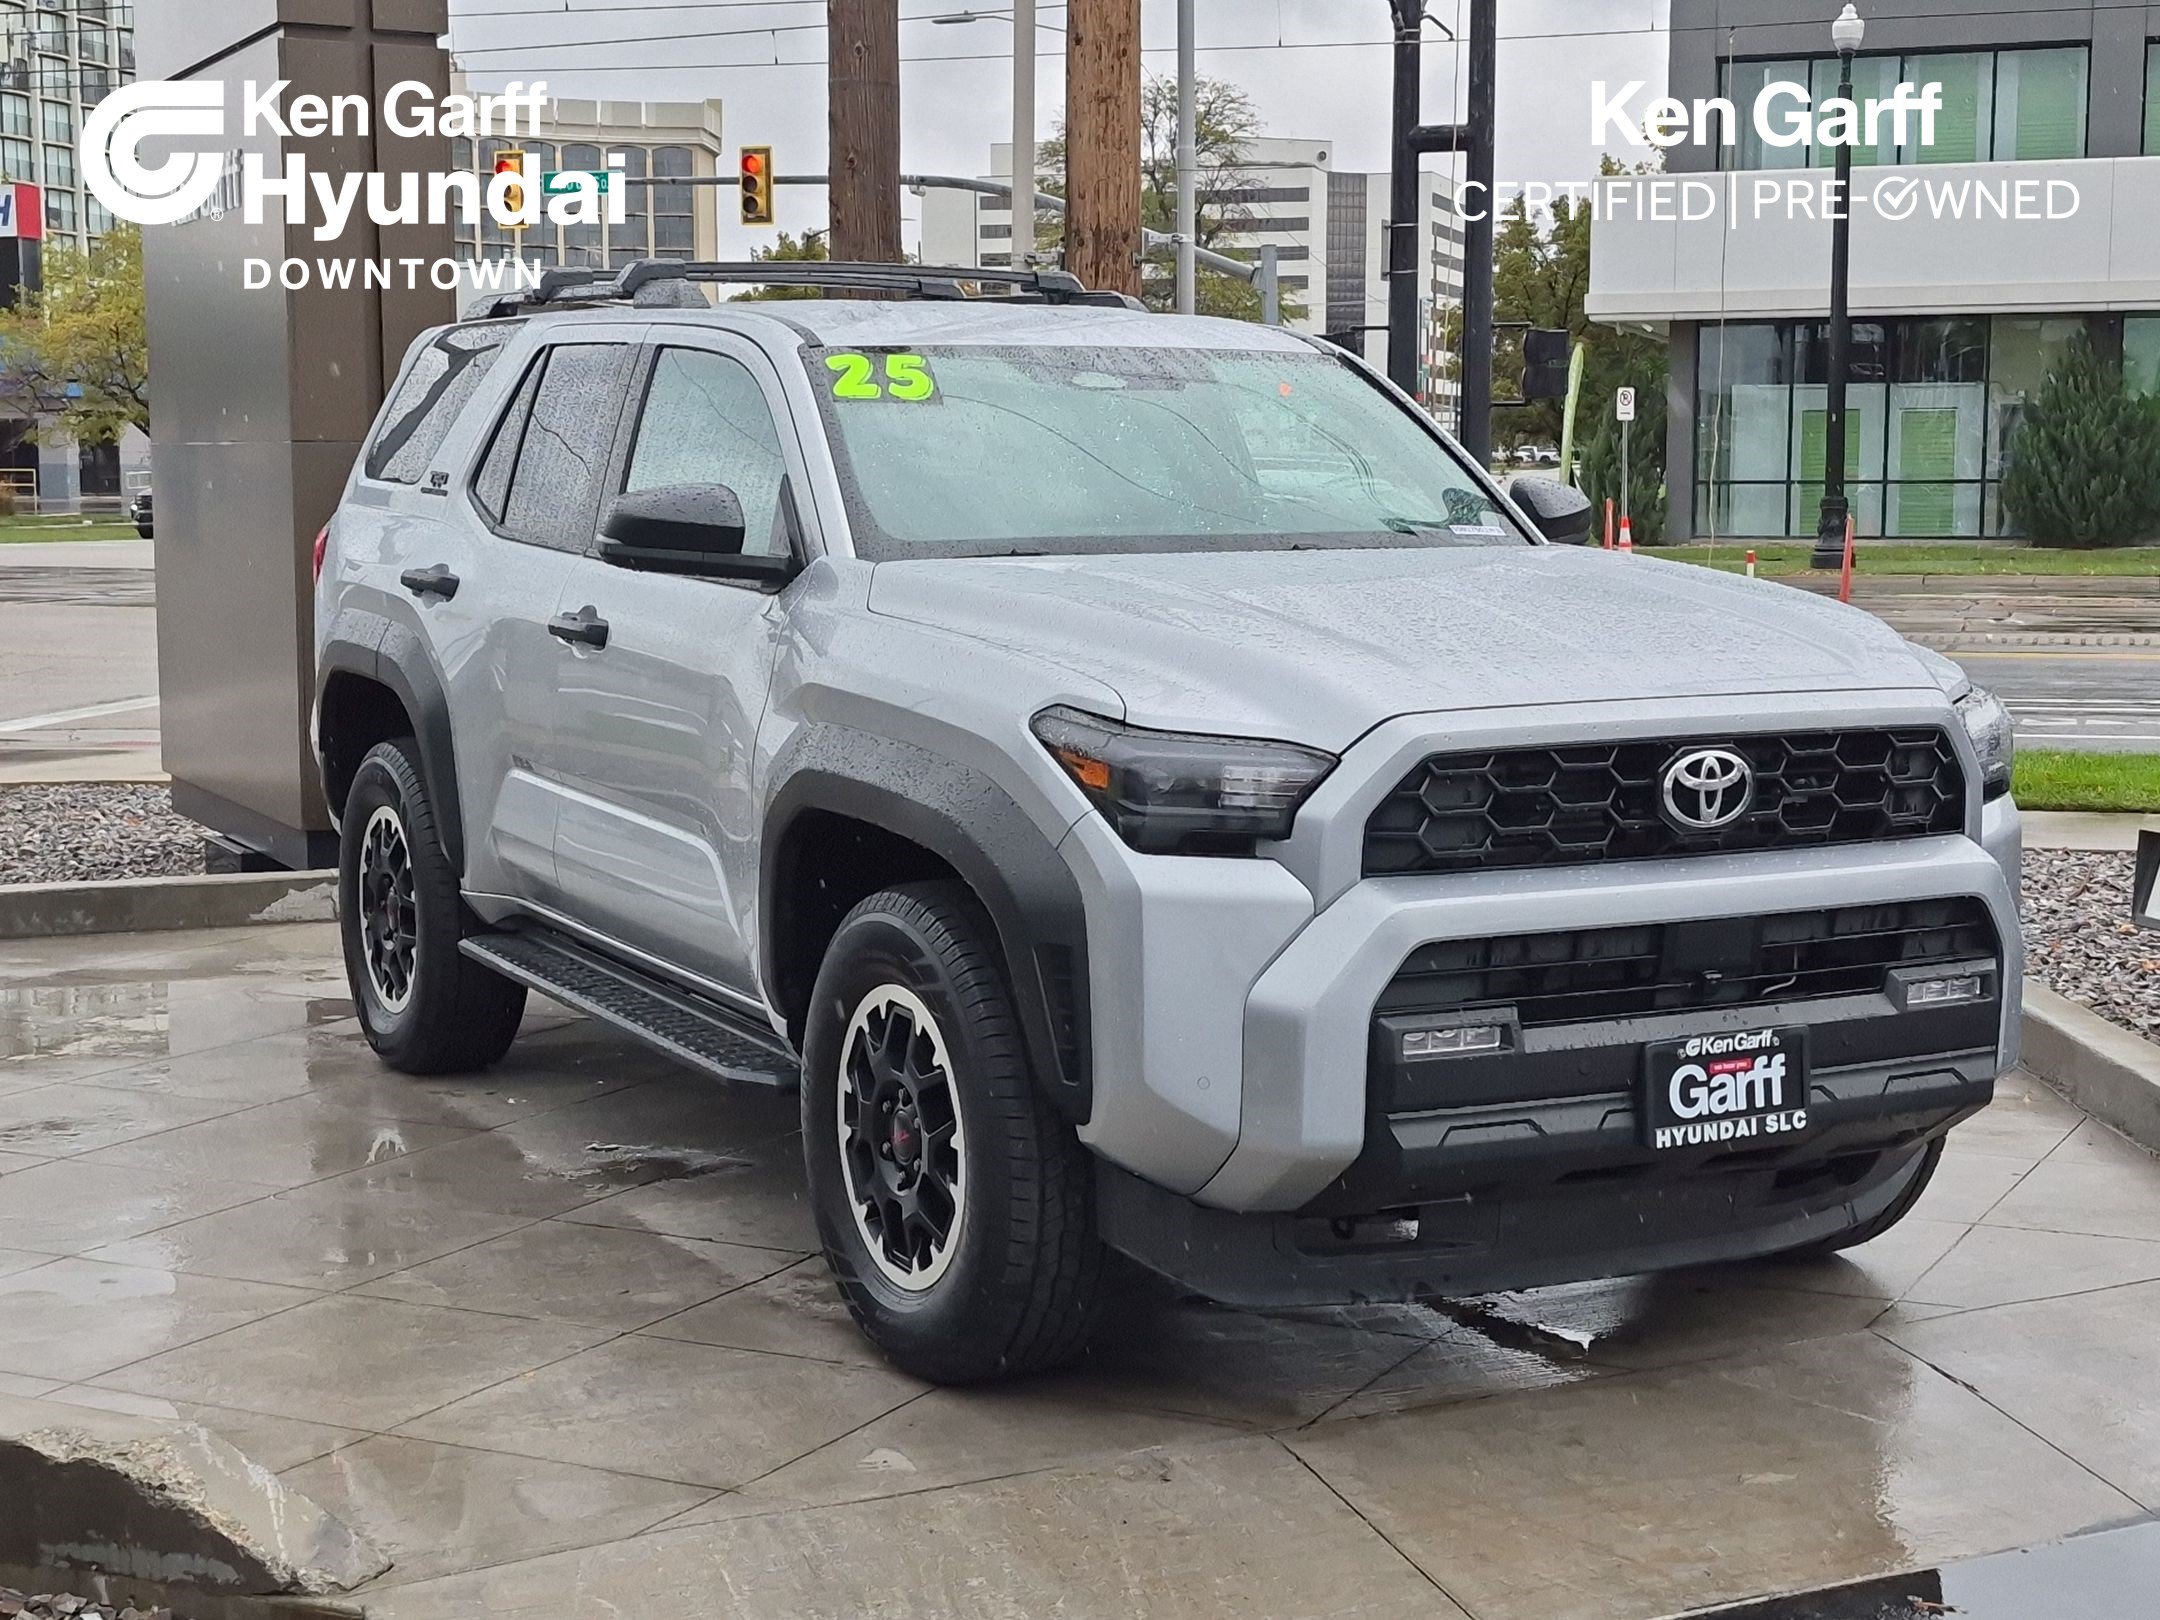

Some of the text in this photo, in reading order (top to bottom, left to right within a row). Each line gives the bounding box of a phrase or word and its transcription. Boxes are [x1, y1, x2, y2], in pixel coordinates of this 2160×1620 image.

[824, 353, 934, 400] 25
[1701, 1029, 1774, 1055] Ken Garff
[1668, 1052, 1786, 1119] Garff
[1655, 1110, 1808, 1149] HYUNDAI SLC
